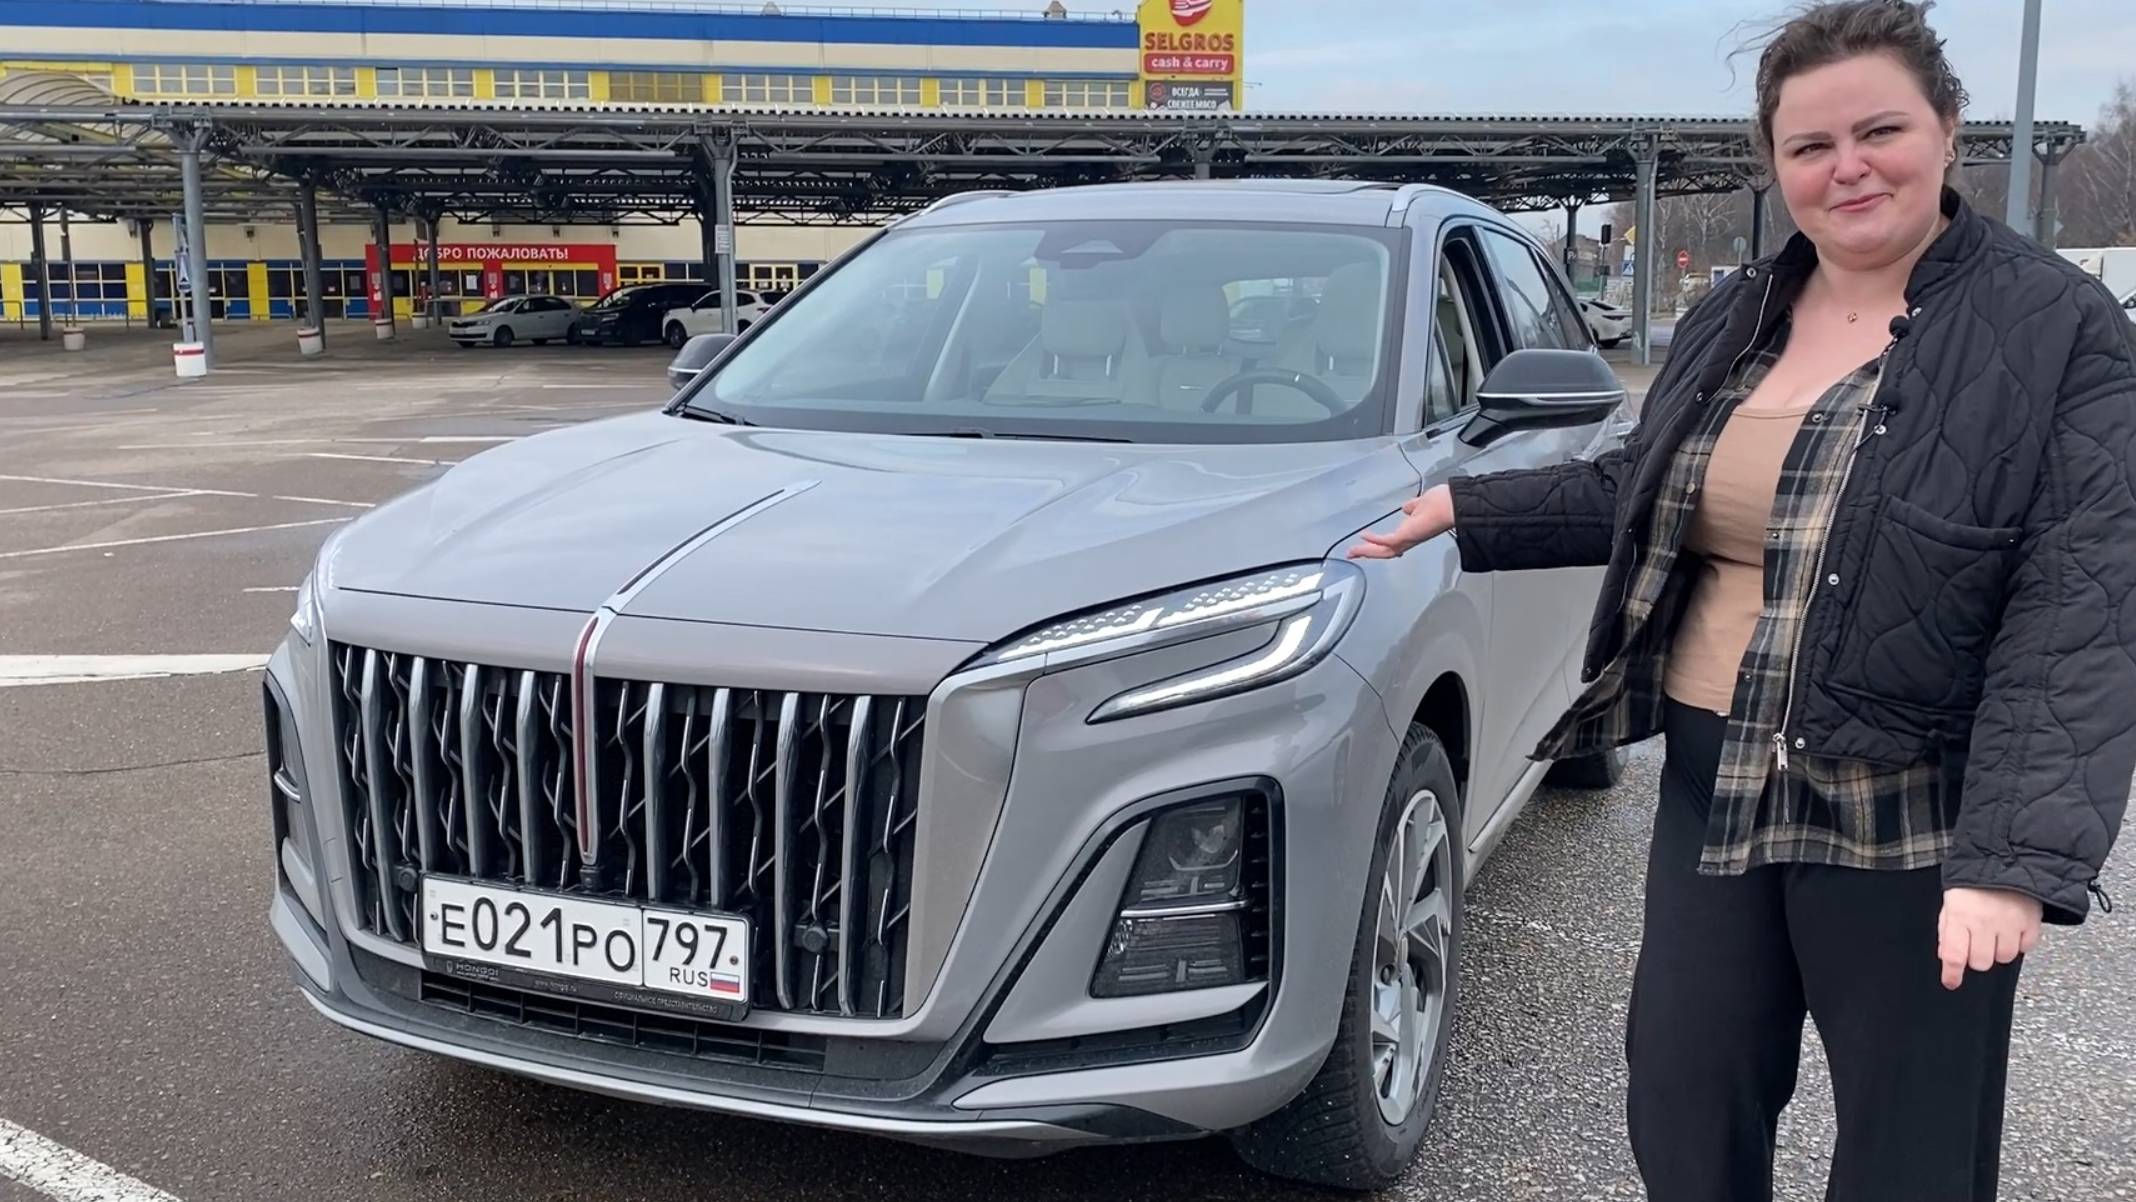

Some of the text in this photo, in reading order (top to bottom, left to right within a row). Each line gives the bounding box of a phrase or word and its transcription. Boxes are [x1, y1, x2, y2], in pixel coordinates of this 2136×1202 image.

[1144, 32, 1235, 51] SELGROS
[1151, 56, 1229, 70] cash & carry
[467, 247, 569, 260] ПОЖАЛОВАТЬ!
[647, 917, 728, 969] 797
[669, 967, 709, 987] RUS
